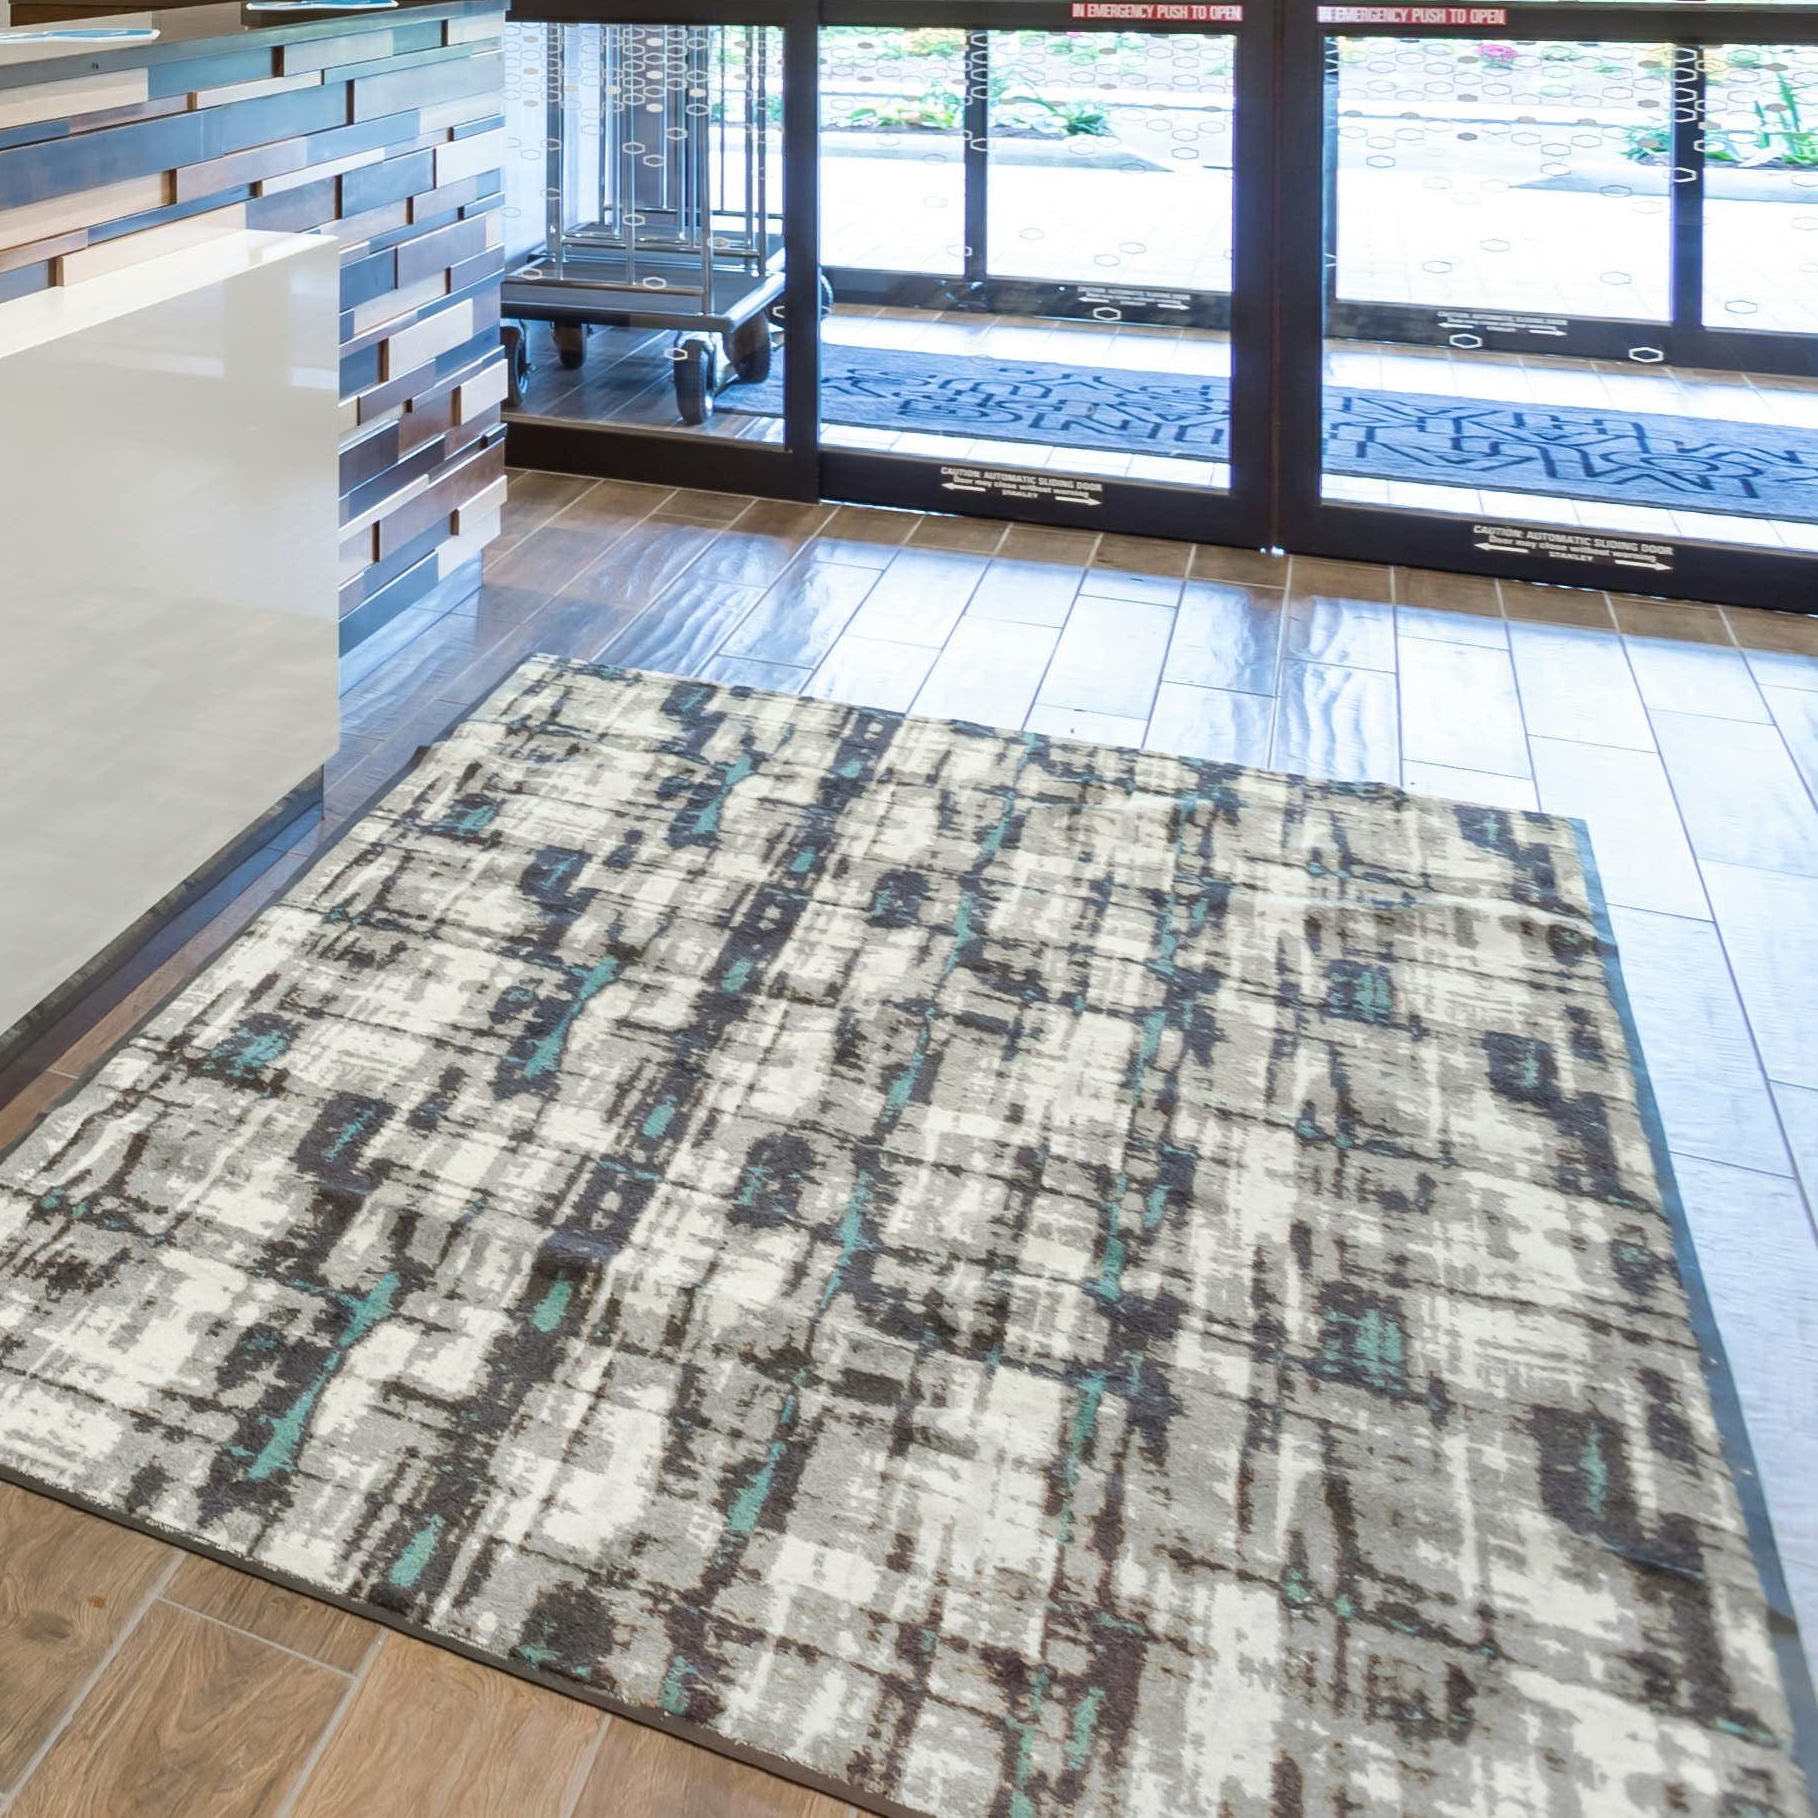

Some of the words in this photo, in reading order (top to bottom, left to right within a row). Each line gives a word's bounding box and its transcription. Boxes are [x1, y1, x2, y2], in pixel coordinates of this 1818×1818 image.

[1071, 3, 1086, 18] IN
[1087, 3, 1153, 19] EMERGENCY
[1157, 4, 1188, 20] PUSH
[1191, 5, 1207, 20] TO
[1209, 5, 1242, 21] OPEN
[1334, 6, 1404, 23] EMERGENCY
[1407, 8, 1446, 23] PUSH
[1450, 9, 1465, 24] TO
[1469, 9, 1506, 25] OPEN
[983, 471, 1037, 485] AUTOMATIC
[1038, 477, 1075, 489] SLIDING
[1076, 481, 1103, 492] DOOR
[1473, 524, 1523, 539] CAUTION:
[1526, 530, 1593, 547] AUTOMATIC
[1594, 538, 1638, 552] SLIDING
[1640, 543, 1674, 556] DOOR
